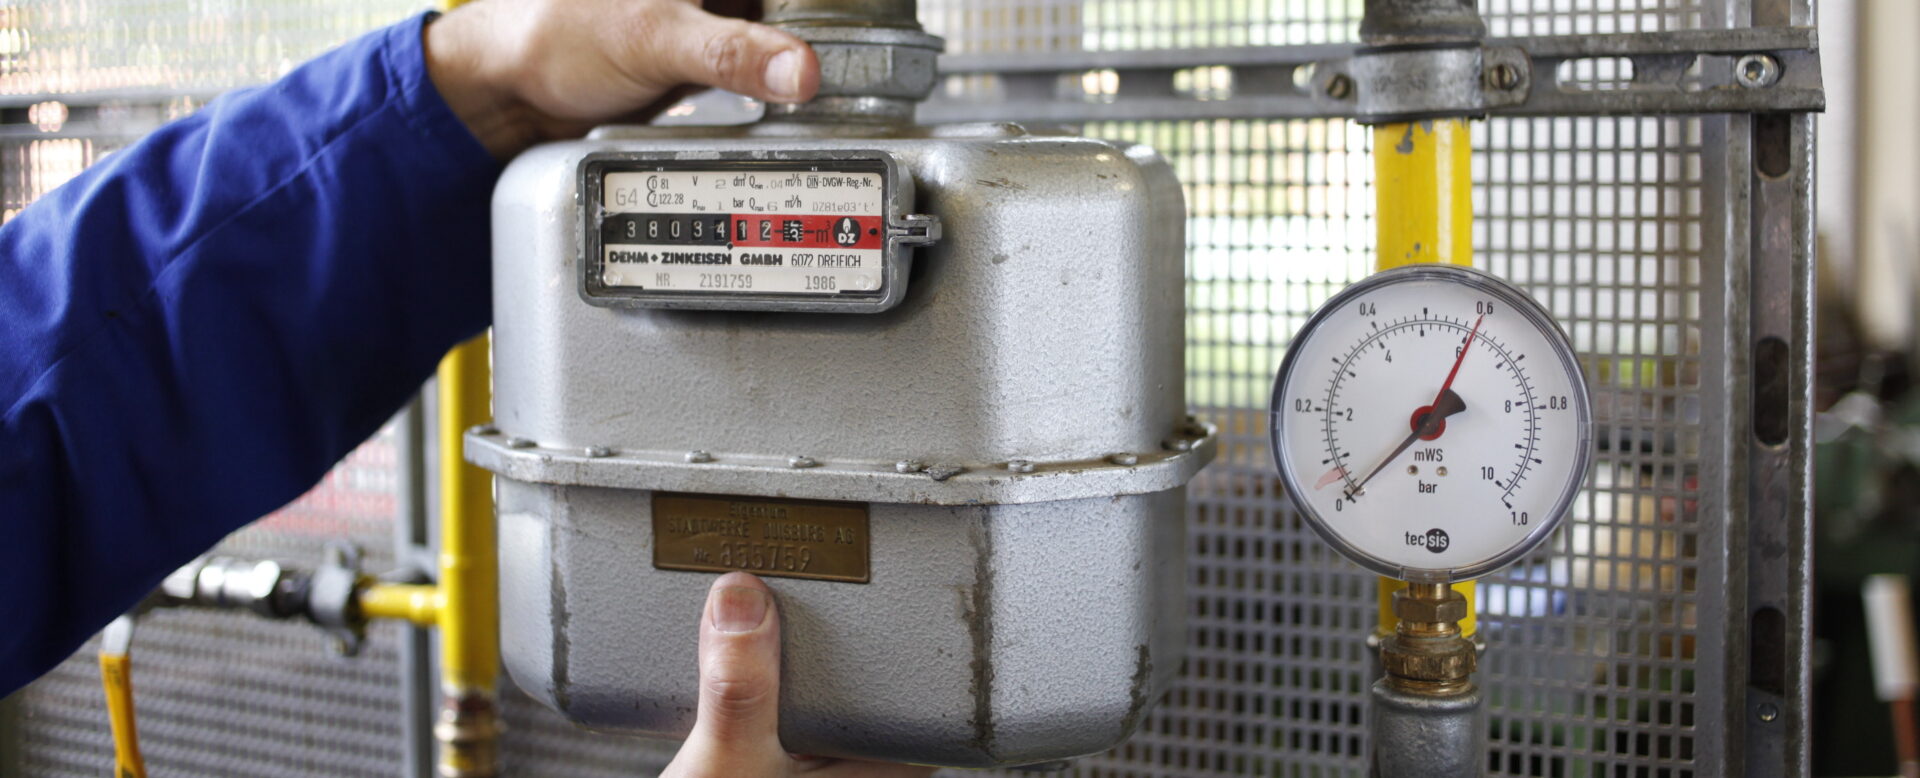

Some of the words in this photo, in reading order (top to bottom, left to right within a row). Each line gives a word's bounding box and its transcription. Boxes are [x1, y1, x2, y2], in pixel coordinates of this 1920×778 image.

[615, 188, 638, 206] G4
[733, 197, 744, 208] bar
[837, 232, 856, 243] DZ
[609, 251, 649, 264] DEHM
[661, 252, 732, 265] ZINKEISEN
[740, 253, 783, 265] GMBH
[791, 253, 814, 267] 6072
[699, 273, 753, 289] 2191759
[805, 275, 836, 290] 1986
[1384, 349, 1392, 363] 4
[1504, 400, 1512, 414] 8
[1346, 408, 1353, 421] 2
[1414, 448, 1444, 462] mWS
[1481, 466, 1494, 480] 10
[1418, 480, 1438, 494] bar
[1335, 498, 1343, 512] 0
